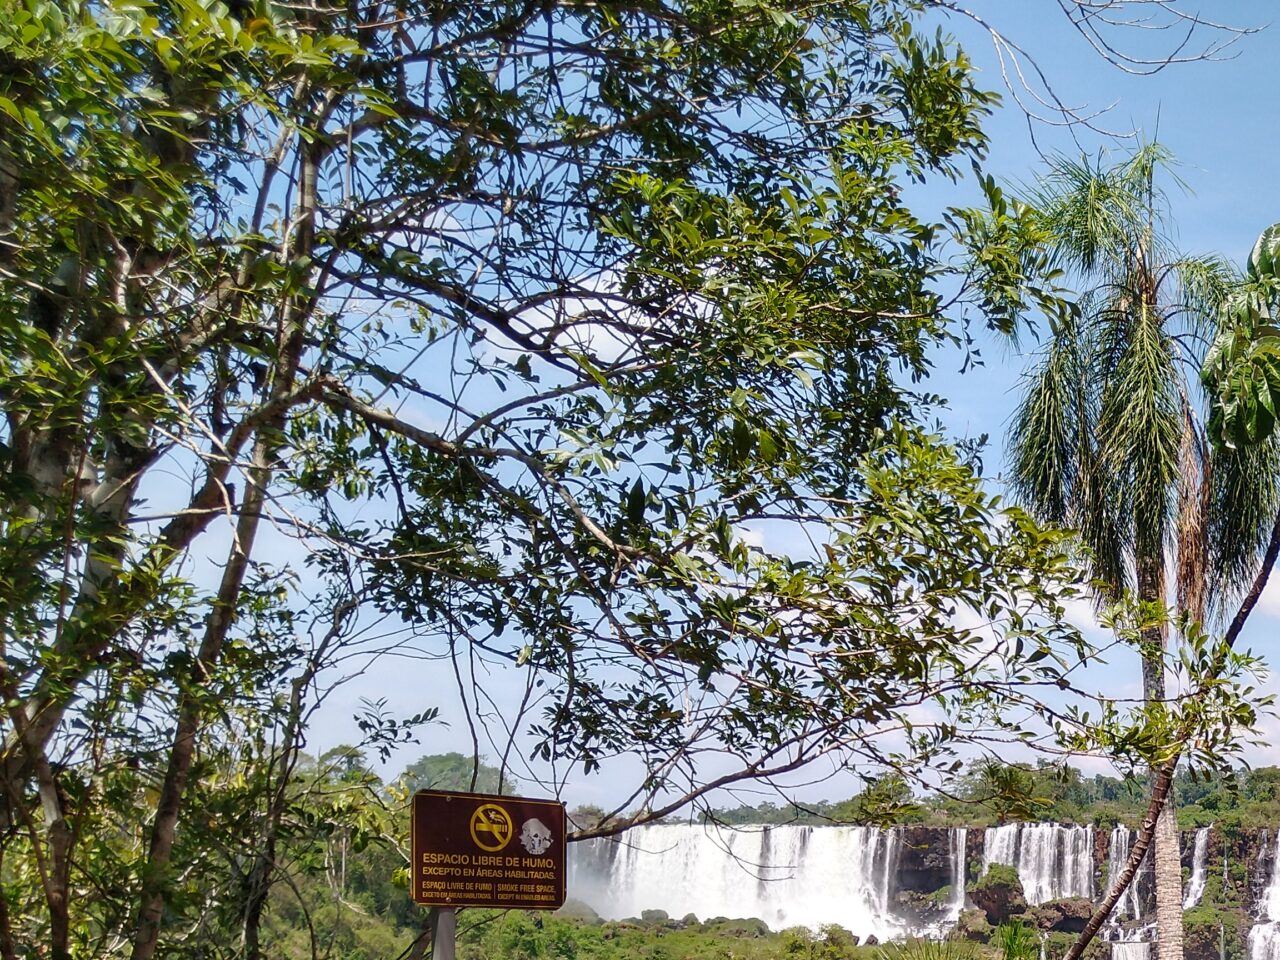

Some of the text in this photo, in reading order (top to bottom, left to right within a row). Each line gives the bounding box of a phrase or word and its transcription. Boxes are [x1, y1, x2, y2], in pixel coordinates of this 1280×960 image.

[423, 853, 556, 870] ESPACIO LIBRE DE HUMO,
[422, 866, 462, 876] EXCEPTO
[463, 868, 475, 877] EN
[476, 867, 503, 878] ÁREAS
[422, 881, 446, 891] ESPAÇO
[465, 882, 474, 890] DE
[497, 883, 519, 892] SMOKE
[520, 884, 535, 893] FREE
